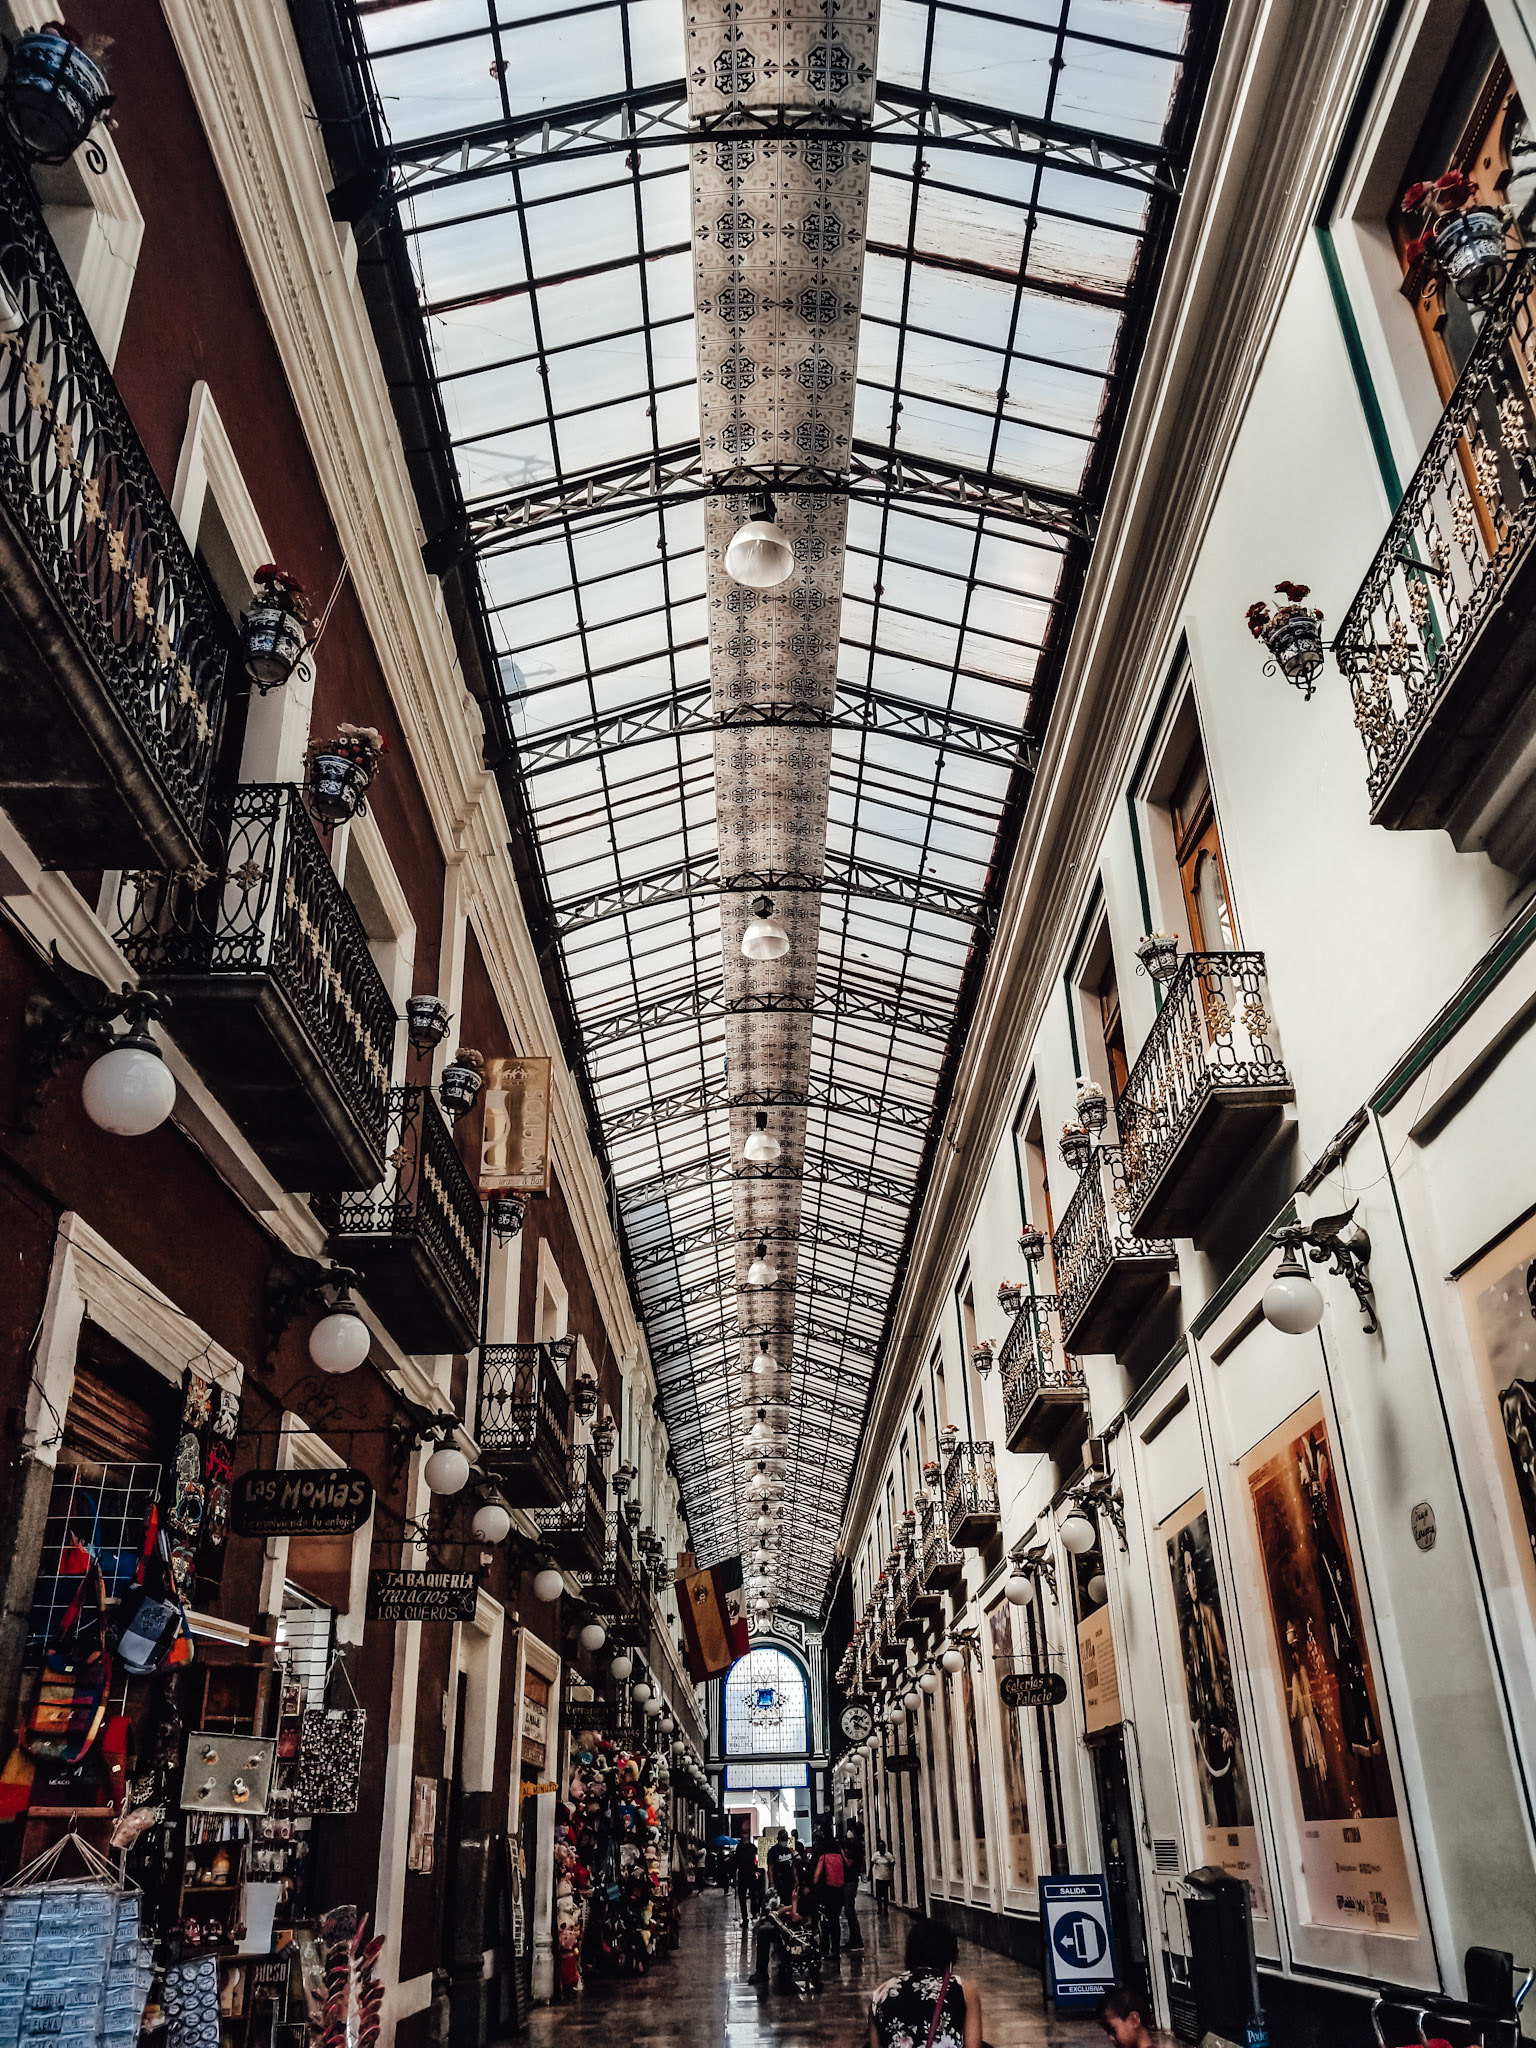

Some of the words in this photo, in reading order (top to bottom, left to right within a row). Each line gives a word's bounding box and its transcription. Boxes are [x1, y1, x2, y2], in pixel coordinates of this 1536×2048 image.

[246, 1480, 276, 1501] Las
[312, 1514, 322, 1527] tu
[378, 1605, 400, 1620] LOS
[1016, 1688, 1053, 1706] Palacio
[1060, 1887, 1087, 1895] SALIDA
[1069, 1985, 1105, 1993] EXCLUSIVA
